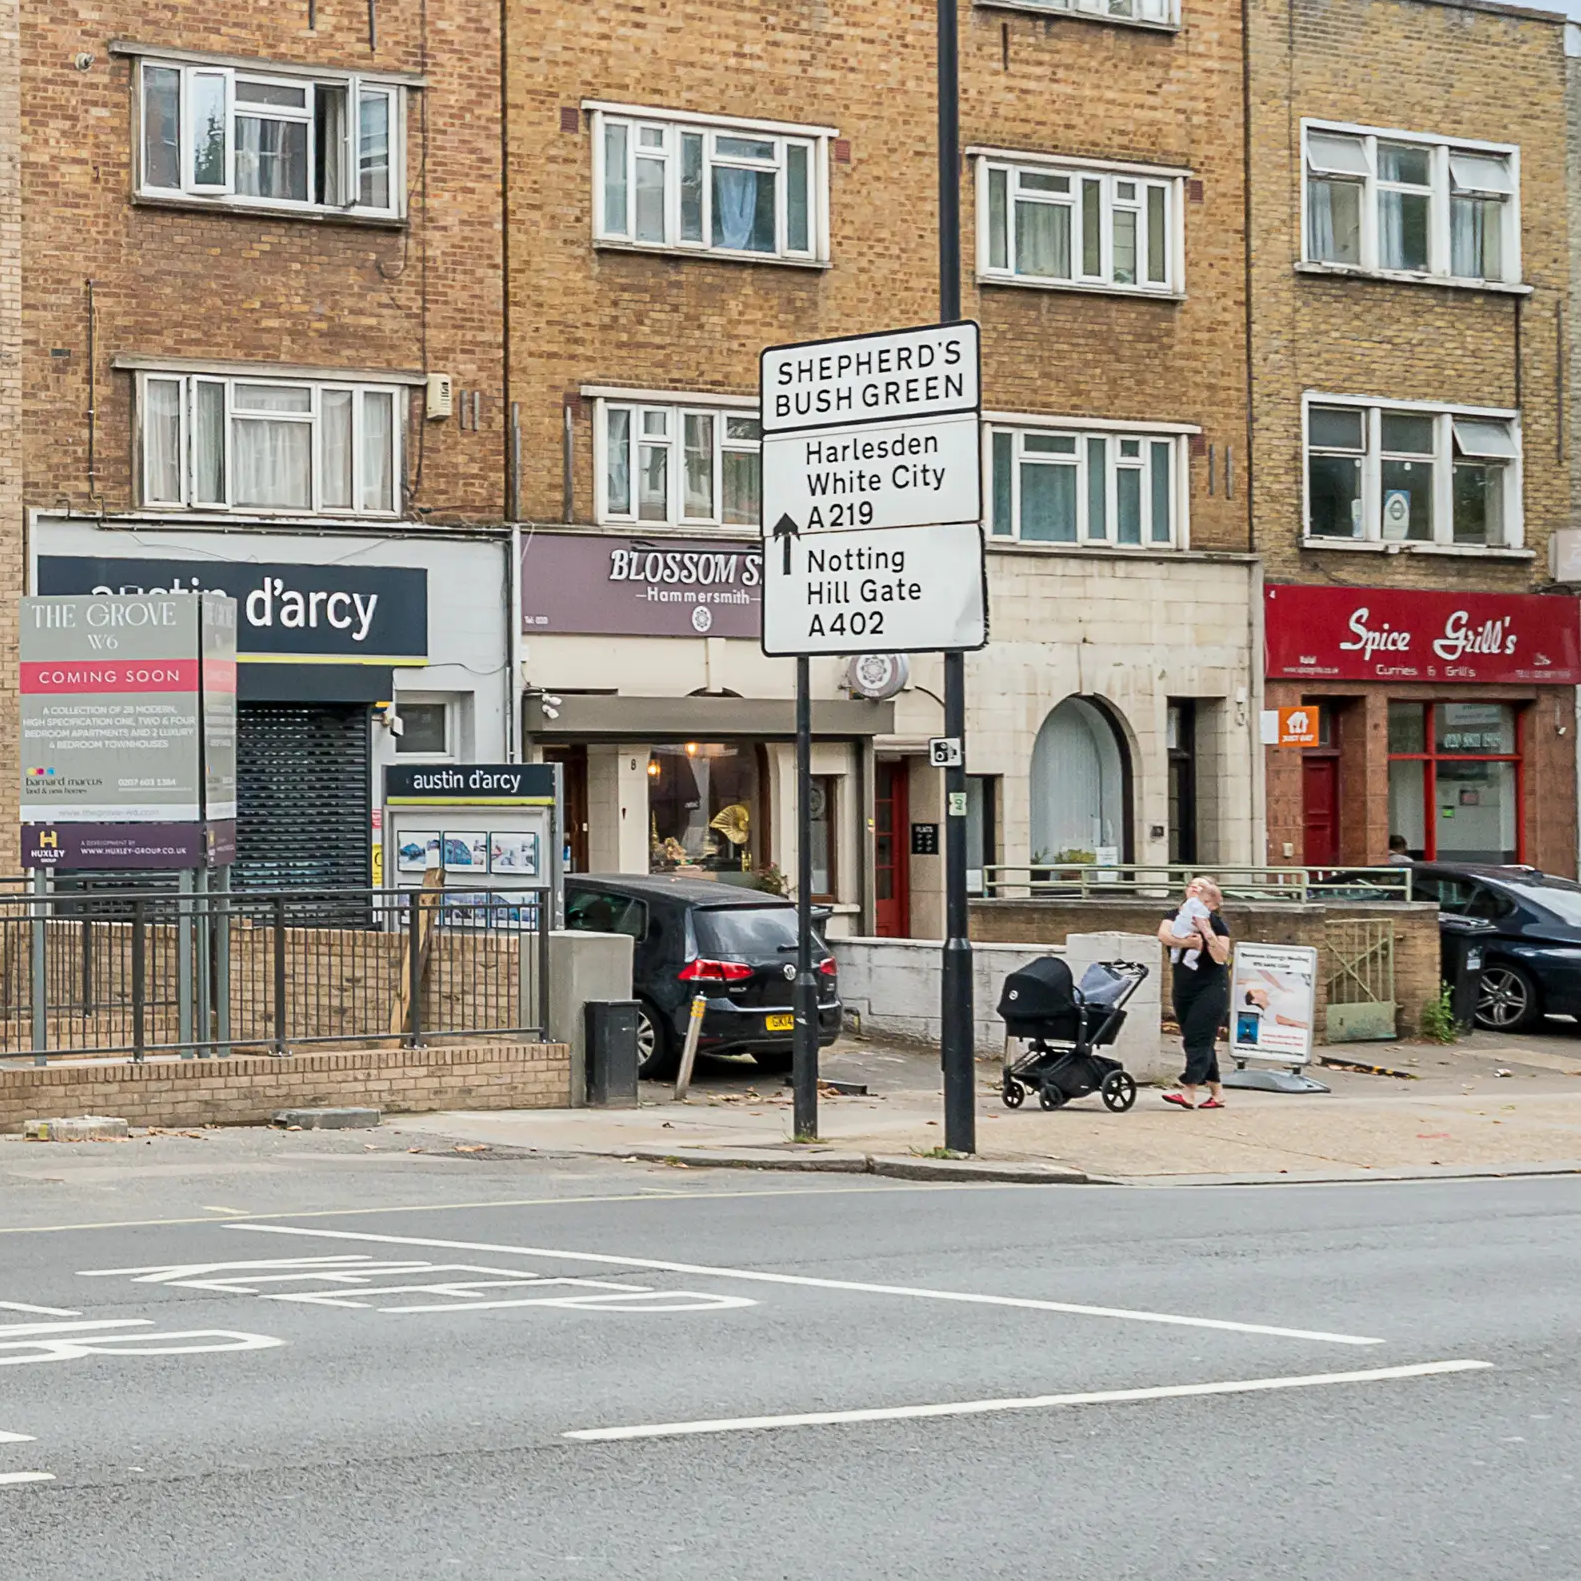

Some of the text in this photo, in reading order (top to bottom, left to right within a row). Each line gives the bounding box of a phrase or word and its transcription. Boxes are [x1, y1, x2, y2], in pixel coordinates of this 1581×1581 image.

[777, 340, 961, 385] SHEPHERD'S
[775, 373, 963, 417] BUSH GREEN
[806, 433, 938, 465] Harlesden
[807, 464, 946, 496] White City
[807, 500, 873, 529] A219
[609, 549, 738, 585] BLOSSOM
[807, 546, 905, 573] Notting
[807, 578, 922, 605] Hill Gate
[31, 604, 76, 629] THE
[86, 601, 177, 628] GROVE
[808, 611, 884, 637] A402
[87, 633, 119, 650] W6
[1340, 607, 1517, 661] Spice Grill's
[38, 669, 180, 684] COMING SOON
[1376, 664, 1418, 676] Curries
[22, 718, 46, 727] HIGH
[46, 717, 113, 727] SPECIFICATION
[138, 717, 160, 726] TWO
[170, 716, 196, 725] FOUR
[43, 707, 49, 715] A
[50, 706, 108, 715] COLLECTION
[109, 706, 121, 714] OF
[24, 729, 70, 738] BEDROOM
[71, 728, 129, 738] APARTMENTS
[131, 728, 150, 736] AND
[159, 728, 194, 736] LUXURY
[56, 740, 102, 749] BEDROOM
[104, 739, 169, 749] TOWNHOUSES
[630, 758, 637, 771] 8
[25, 777, 103, 786] barnard marcus
[413, 770, 464, 789] austin
[30, 850, 66, 859] HUXLEY
[80, 847, 187, 855] WWW.HUXLEY-GROUP.CO.UK
[74, 1254, 760, 1314] KEEP
